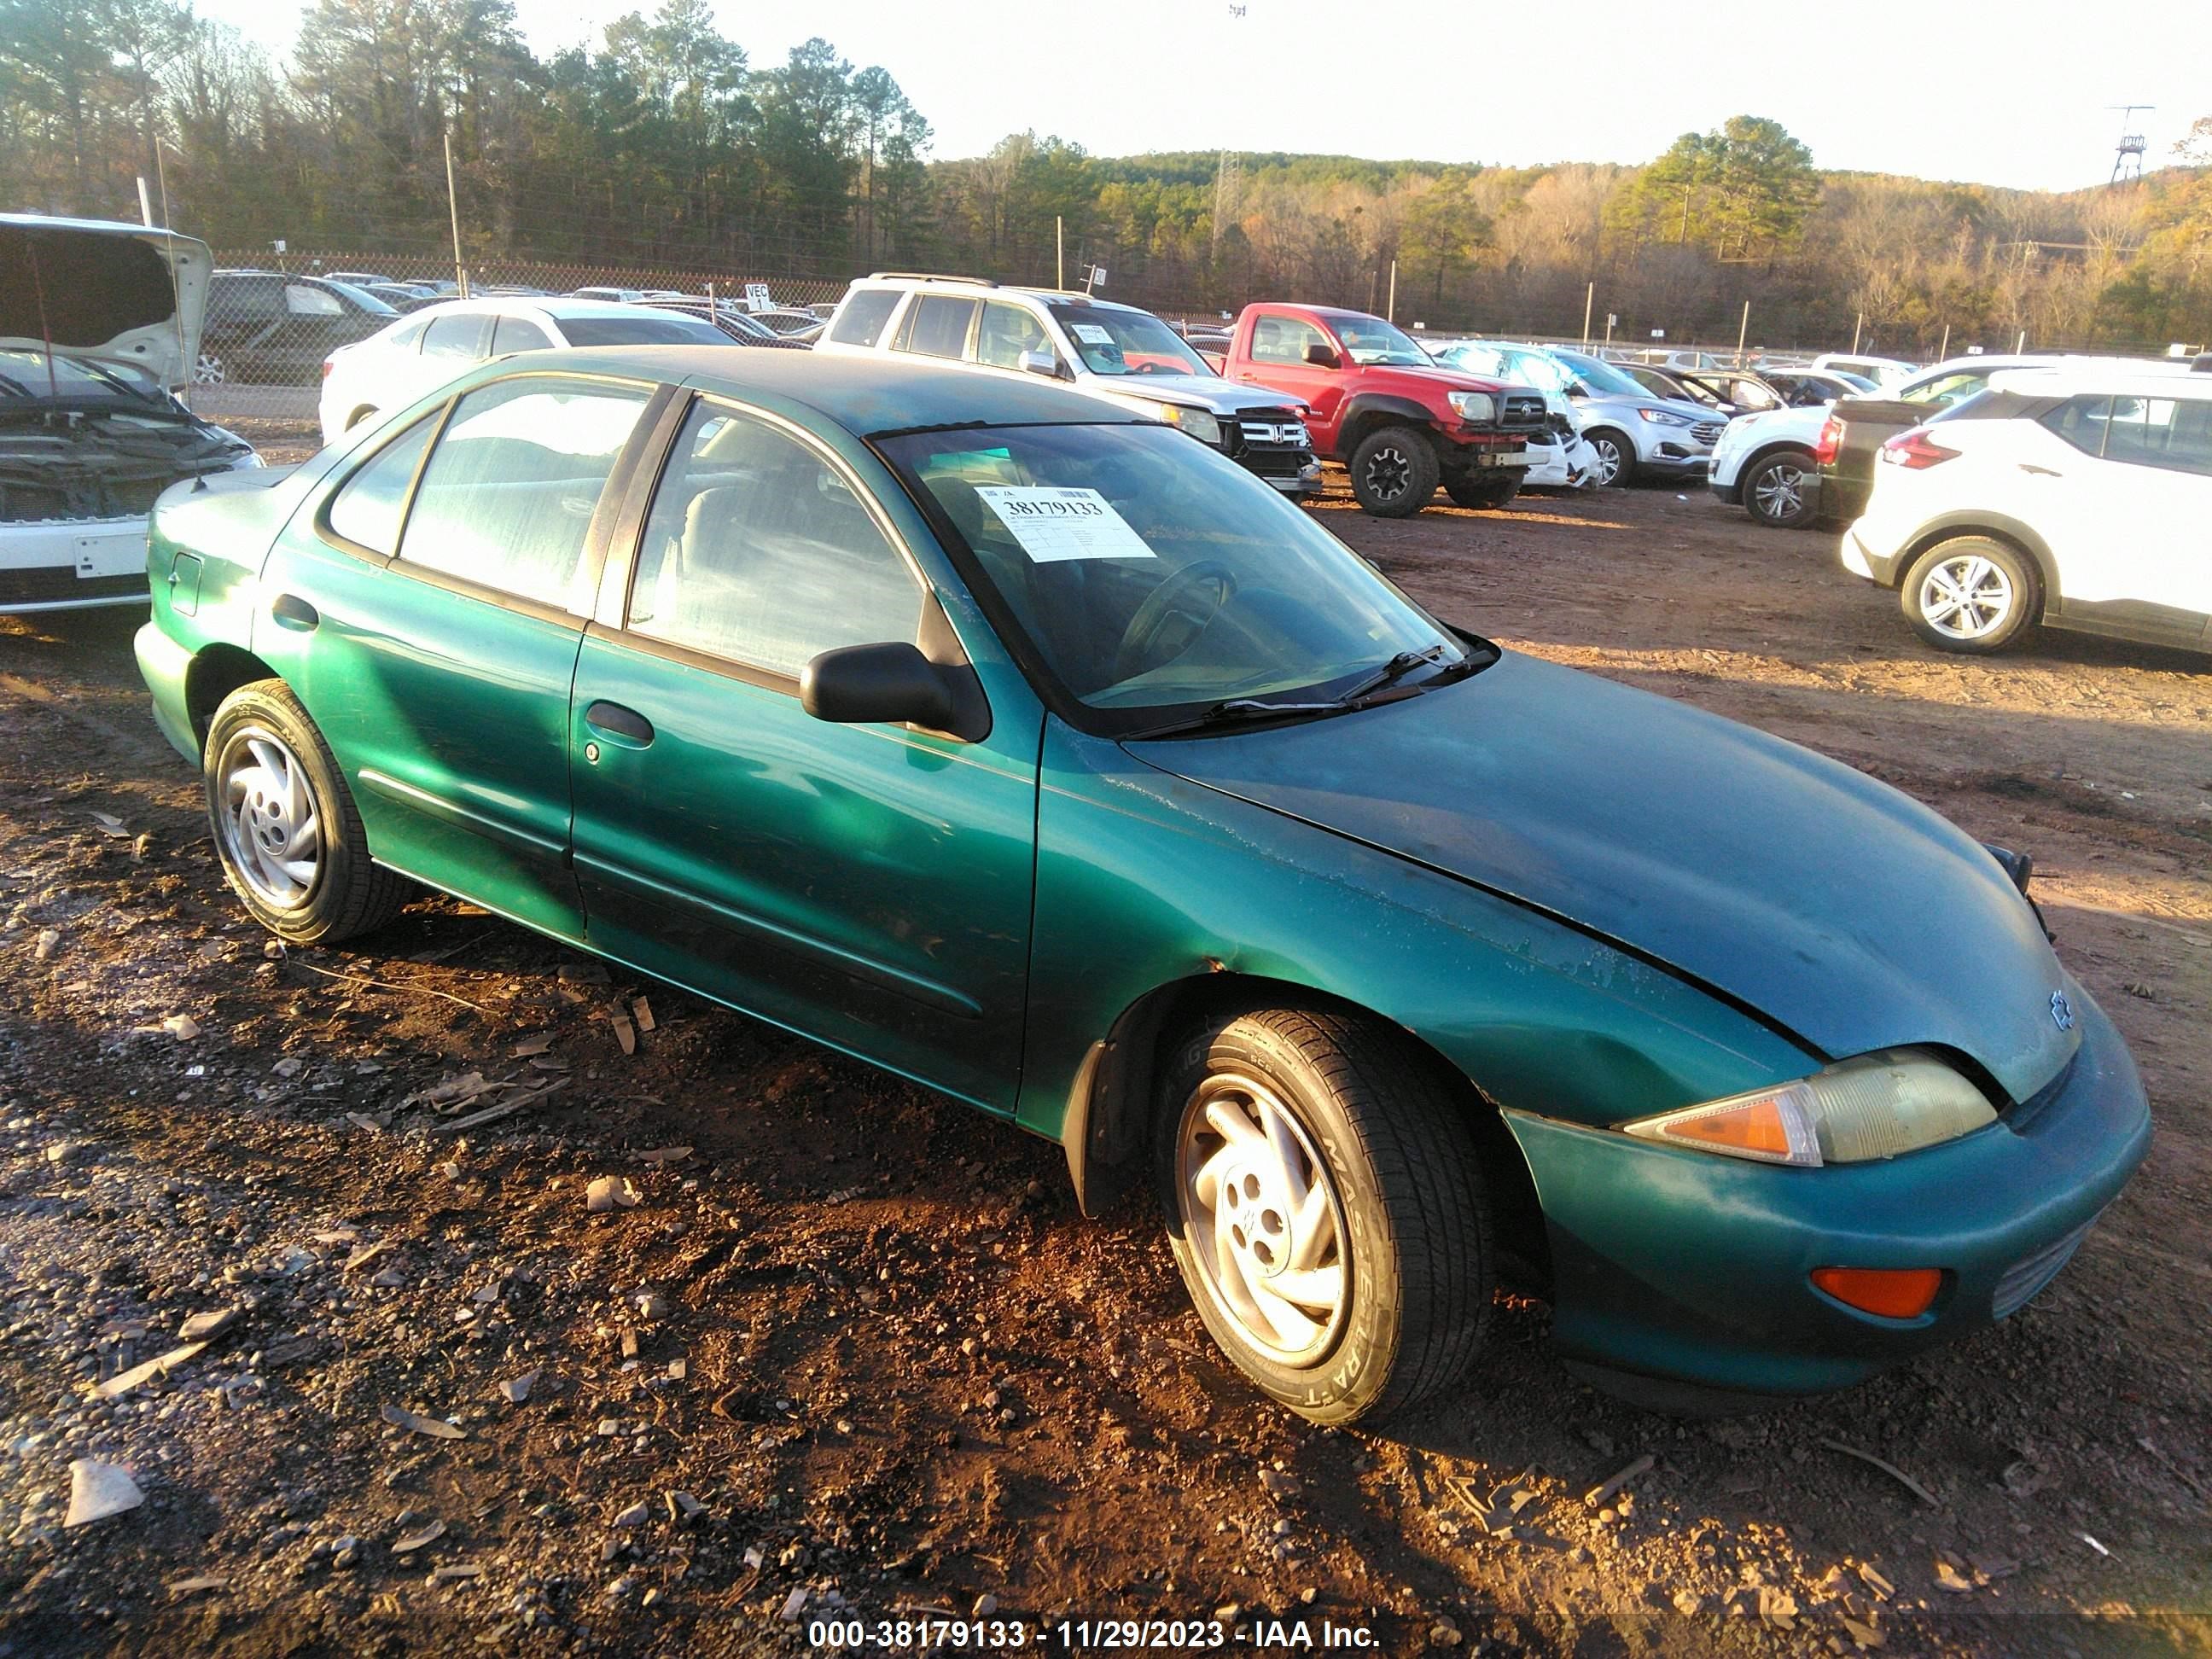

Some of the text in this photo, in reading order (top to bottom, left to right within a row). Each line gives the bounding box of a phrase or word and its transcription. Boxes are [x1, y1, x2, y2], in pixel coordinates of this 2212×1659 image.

[747, 285, 767, 298] VEC
[757, 298, 762, 310] 1
[1003, 501, 1103, 515] 38179133
